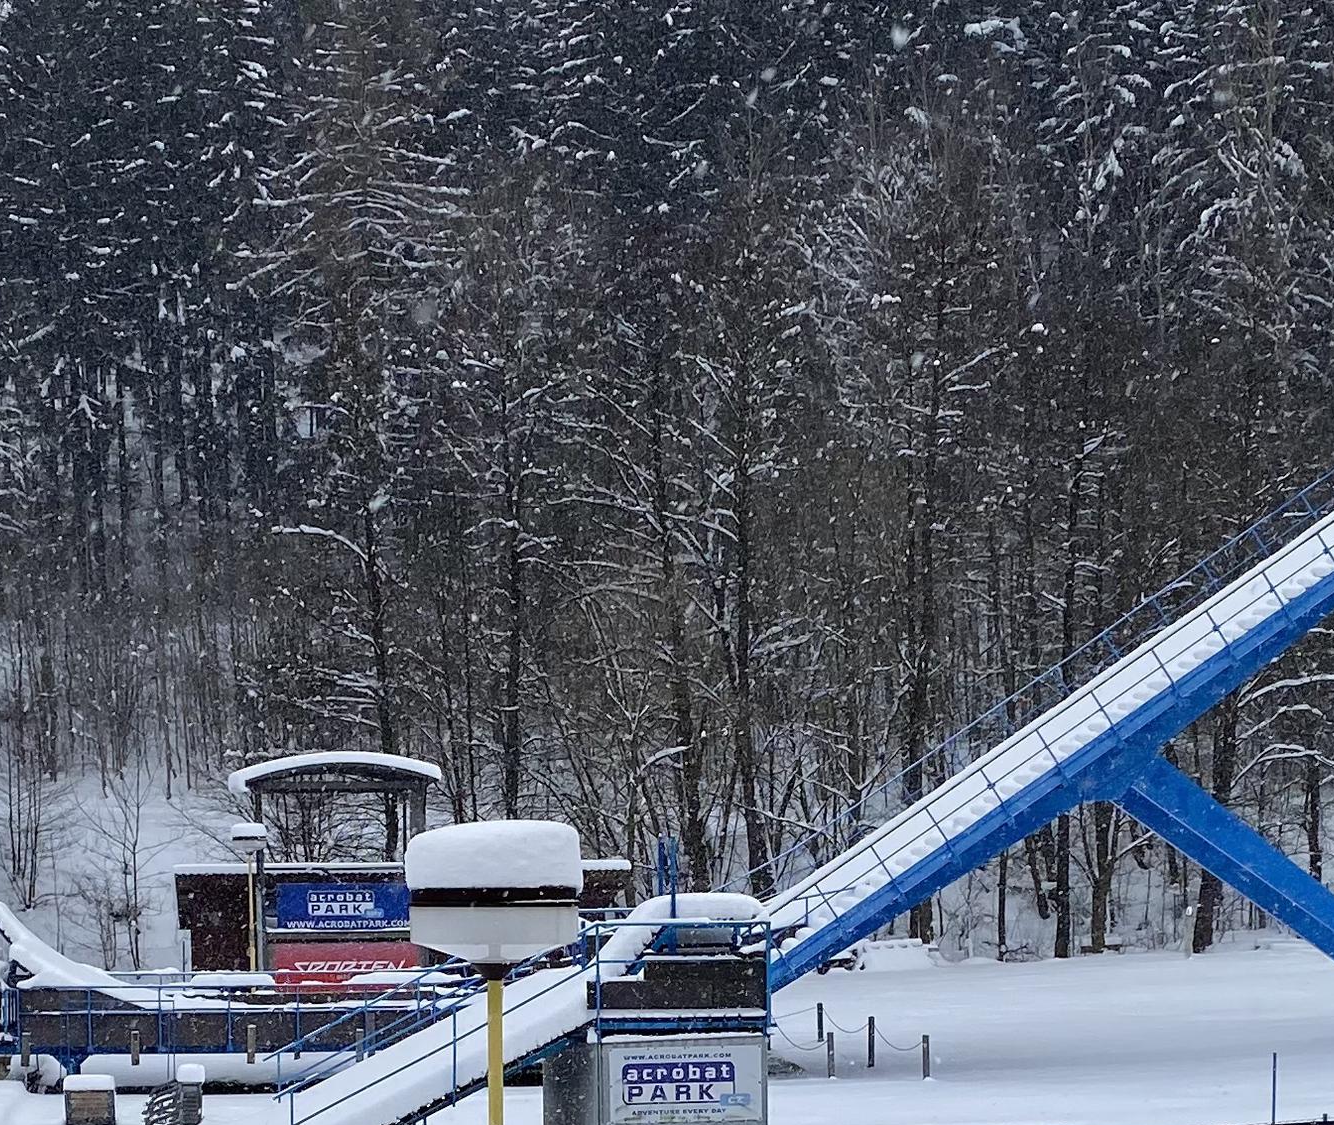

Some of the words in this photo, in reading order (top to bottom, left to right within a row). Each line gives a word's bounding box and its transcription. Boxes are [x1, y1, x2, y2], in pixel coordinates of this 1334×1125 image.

[310, 892, 371, 902] acrobat
[312, 904, 362, 914] PARK
[626, 1064, 730, 1081] acrobat
[628, 1084, 715, 1102] PARK
